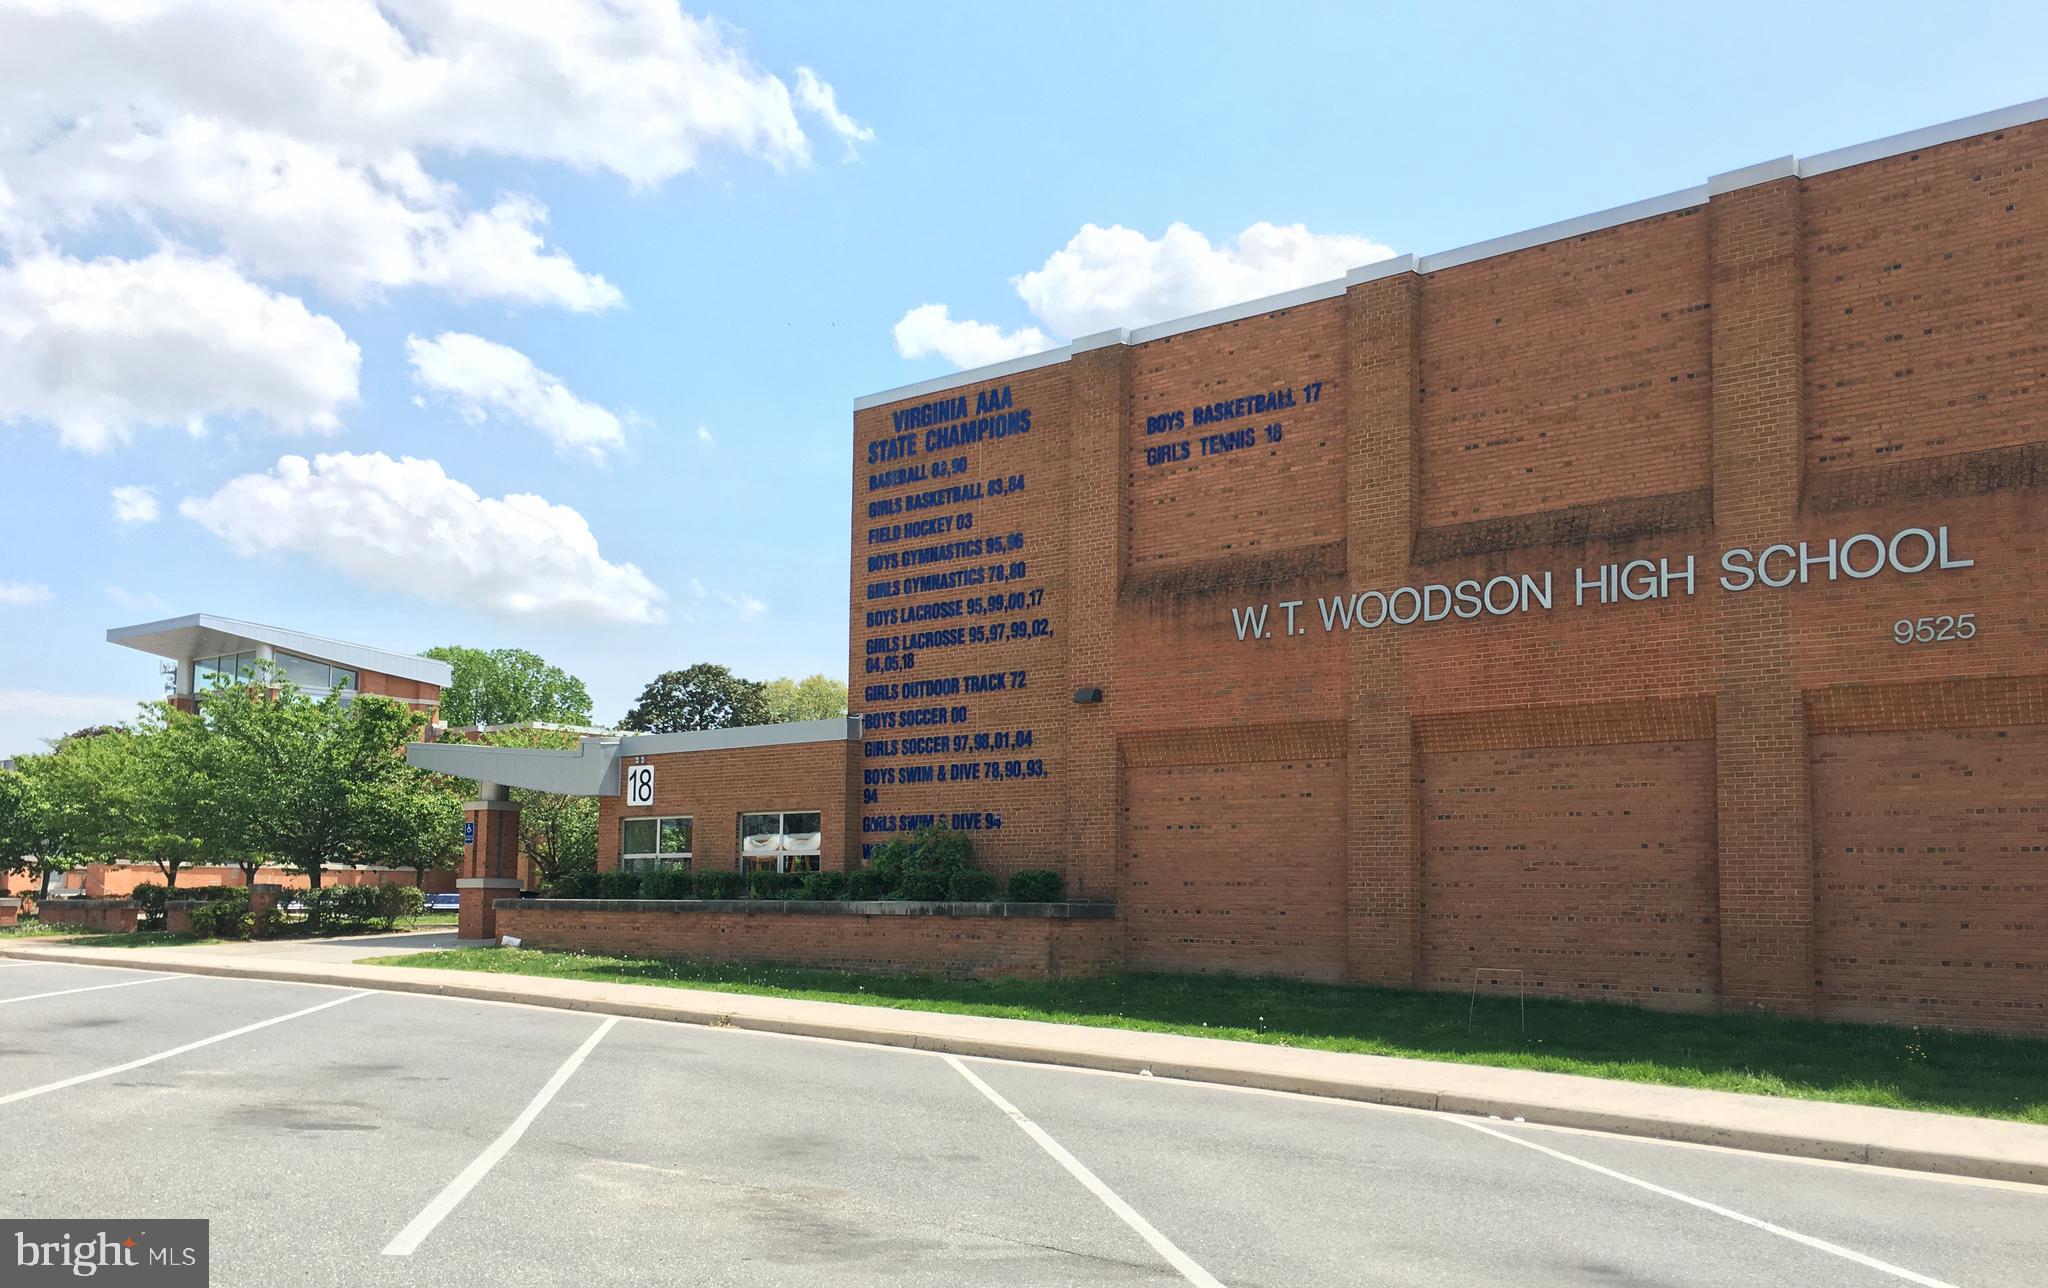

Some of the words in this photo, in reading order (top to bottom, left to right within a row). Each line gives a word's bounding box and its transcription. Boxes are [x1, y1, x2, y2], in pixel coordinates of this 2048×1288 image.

[893, 396, 968, 432] VIRGINIA
[976, 385, 1013, 415] AAA
[1146, 410, 1185, 435] BOYS
[1192, 387, 1296, 426] BASKETBALL
[1303, 382, 1322, 404] 17
[868, 433, 917, 464] STATE
[925, 409, 1031, 453] CHAMPIONS
[1200, 427, 1255, 456] TENNIS
[869, 464, 928, 491] BASEBALL
[868, 499, 902, 518] GIRLS
[906, 482, 984, 512] BASKETBALL
[868, 524, 900, 544] FIELD
[904, 515, 953, 539] HOCKEY
[956, 512, 973, 530] 03
[868, 552, 898, 572] BOYS
[902, 538, 982, 568] GYMNASTICS
[867, 580, 900, 600] GIRLS
[904, 567, 985, 595] GYMNASTICS
[1232, 604, 1271, 641] W.
[1279, 600, 1305, 636] T.
[1318, 572, 1552, 632] WOODSON
[1576, 555, 1695, 606] HIGH
[1720, 526, 1975, 592] SCHOOL
[866, 609, 898, 628] BOYS
[900, 599, 963, 624] LACROSSE
[1893, 614, 1977, 644] 9525
[866, 636, 899, 655] GIRLS
[902, 627, 965, 650] LACROSSE
[865, 685, 899, 702] GIRLS
[901, 679, 960, 699] OUTDOOR
[963, 673, 1006, 693] TRACK
[1009, 670, 1026, 688] 72
[864, 712, 896, 730] BOYS
[899, 708, 947, 728] SOCCER
[951, 706, 967, 723] 00
[864, 740, 898, 758] GIRLS
[901, 736, 949, 756] SOCCER
[629, 769, 651, 802] 18
[864, 767, 895, 785] BOYS
[898, 765, 933, 784] SWIM
[937, 764, 946, 782] &
[950, 762, 980, 780] DIVE
[863, 788, 878, 804] 94
[863, 815, 896, 832] GIRLS
[899, 814, 934, 831] SWIM
[952, 813, 982, 830] DIVE
